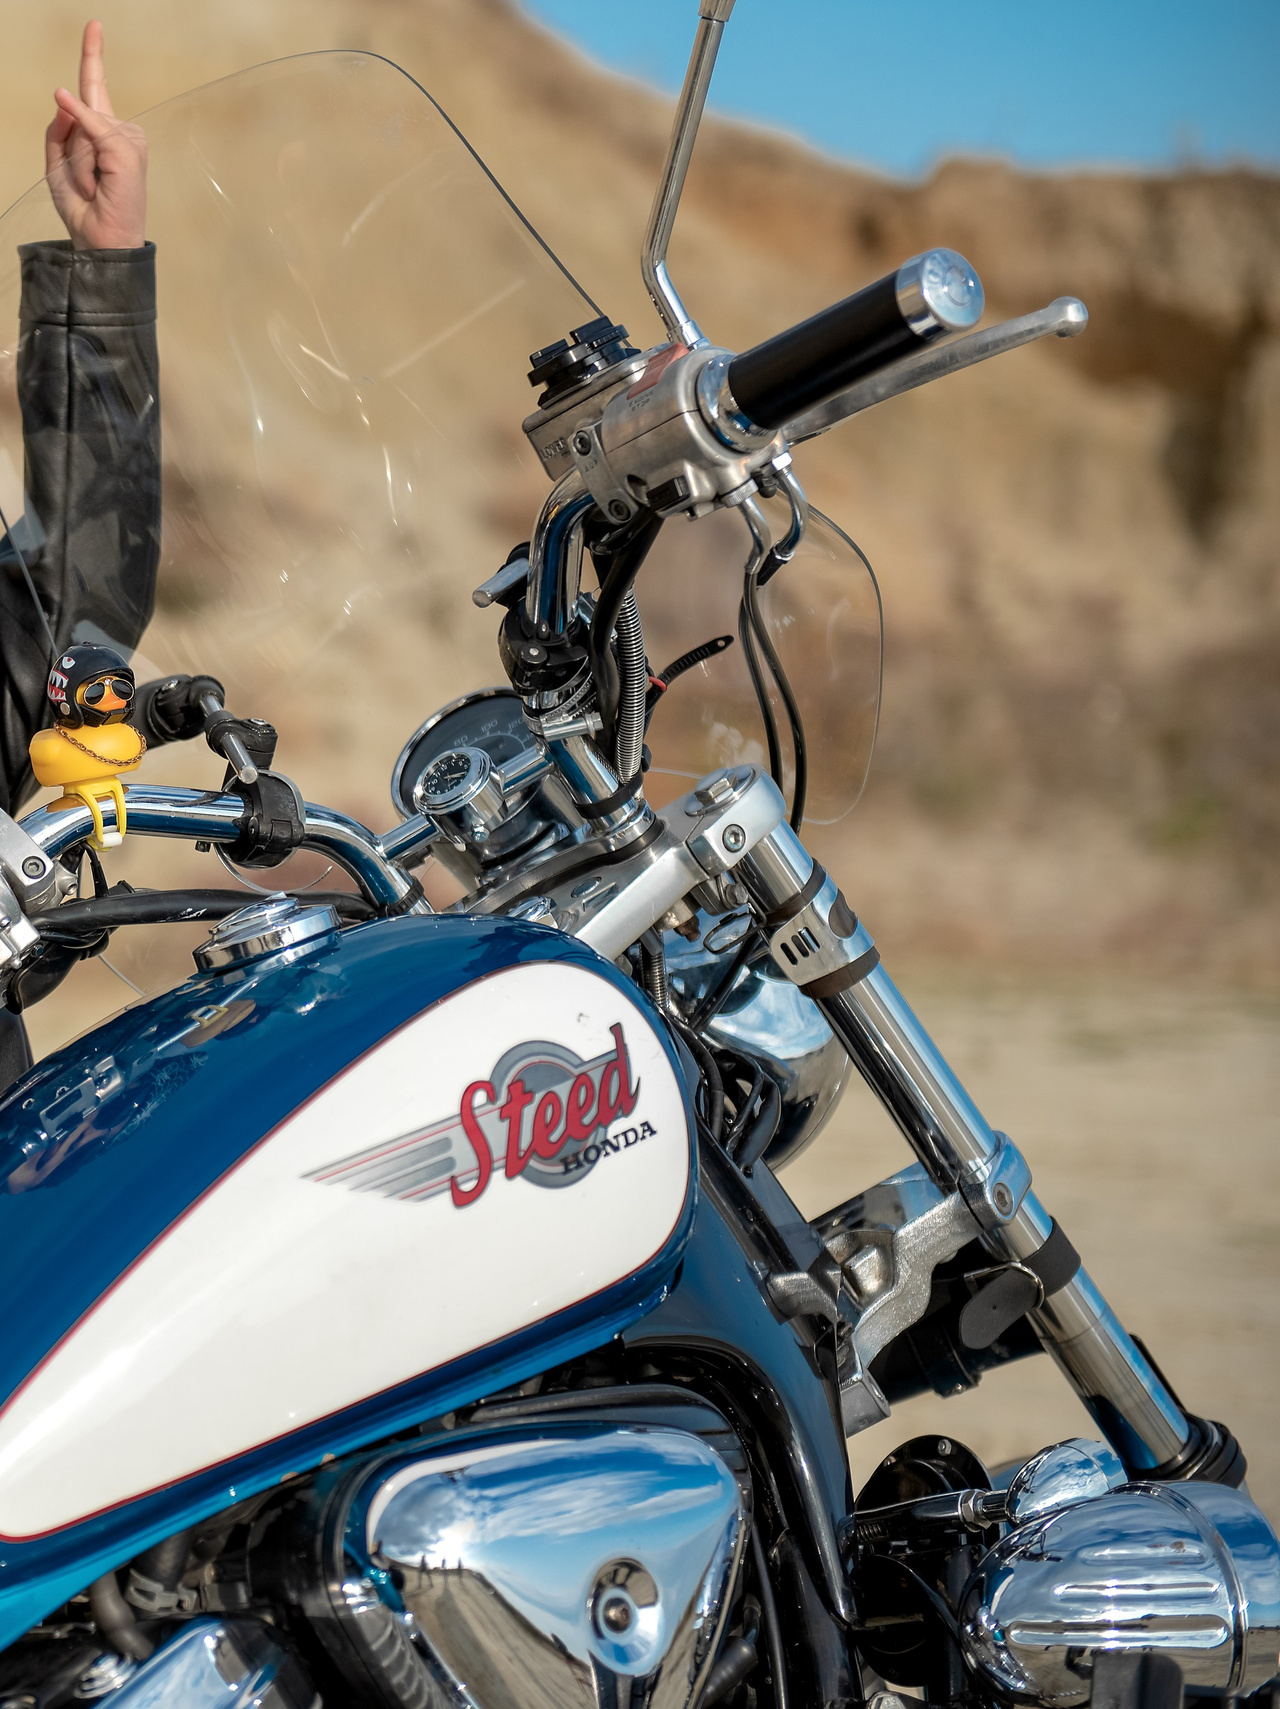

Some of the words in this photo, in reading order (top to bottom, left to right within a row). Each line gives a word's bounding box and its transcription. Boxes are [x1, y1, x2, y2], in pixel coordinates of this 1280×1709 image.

[454, 735, 468, 746] 80
[481, 720, 498, 732] 100
[449, 1022, 641, 1208] Steed
[559, 1120, 658, 1176] HONDA
